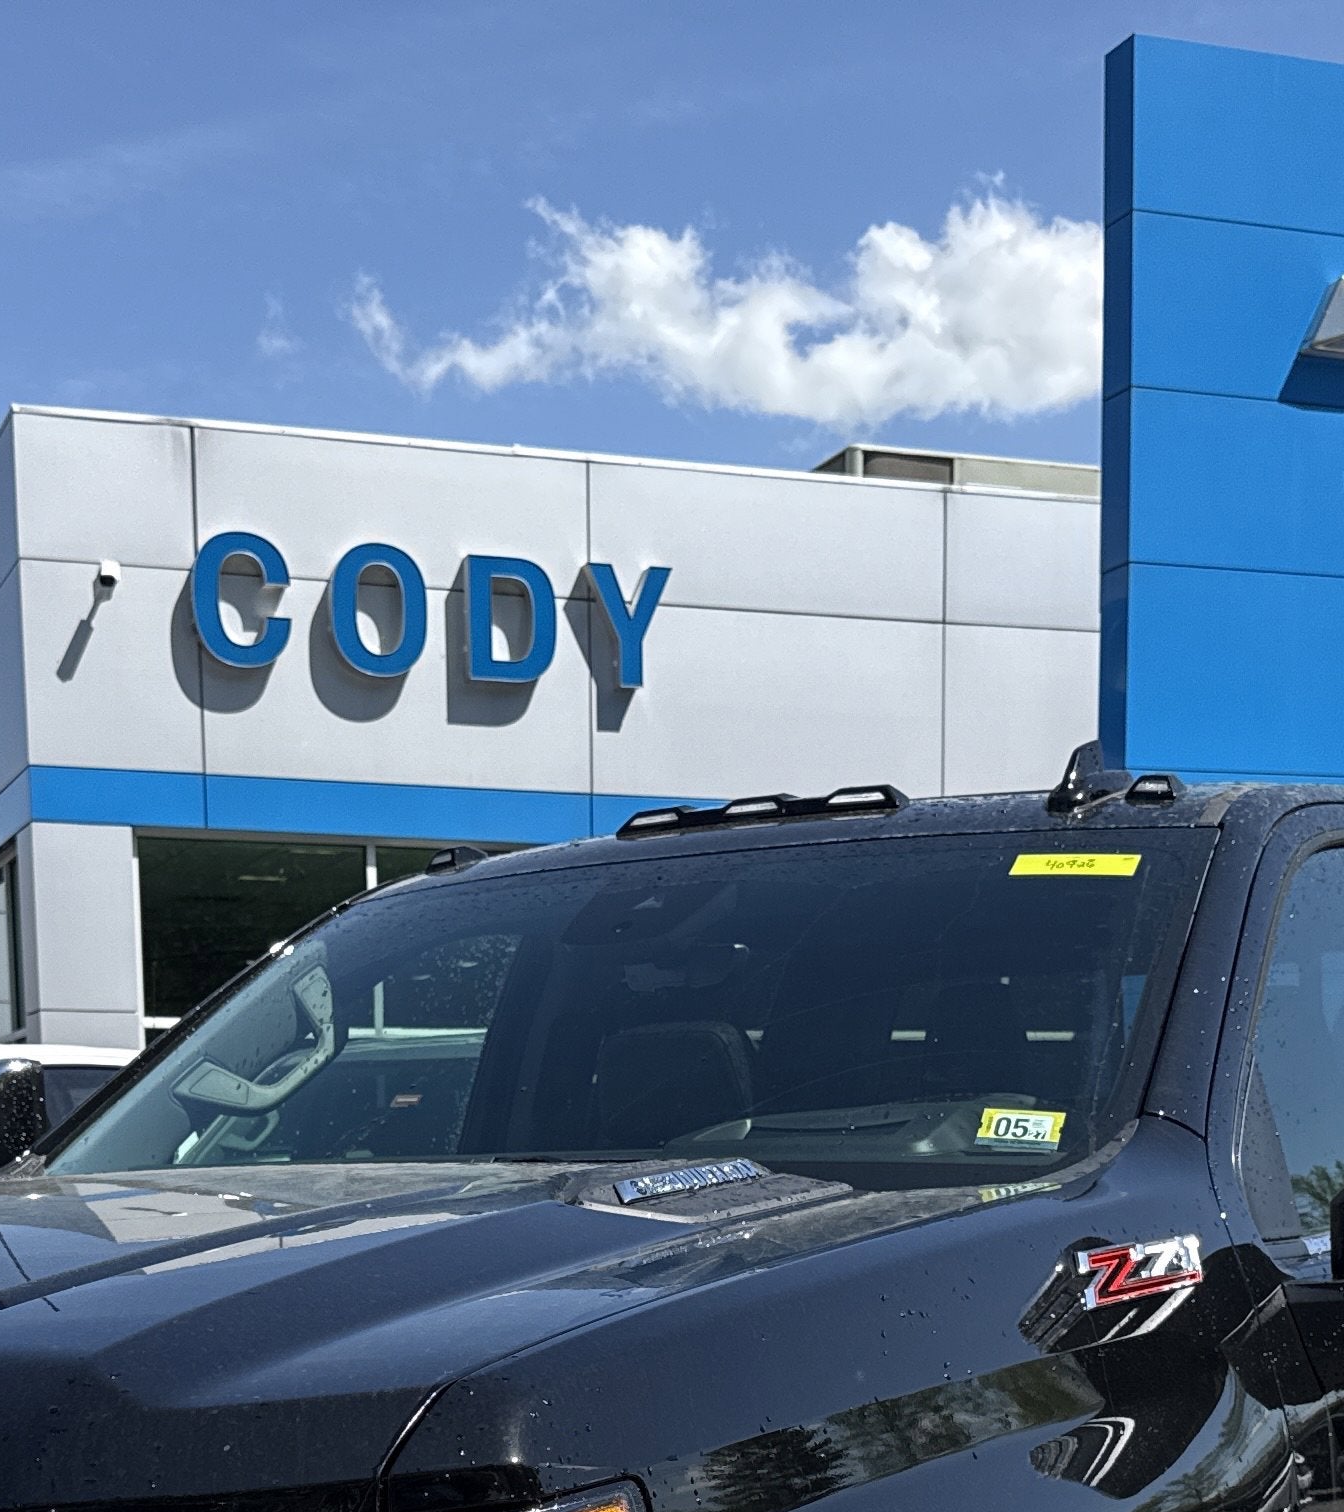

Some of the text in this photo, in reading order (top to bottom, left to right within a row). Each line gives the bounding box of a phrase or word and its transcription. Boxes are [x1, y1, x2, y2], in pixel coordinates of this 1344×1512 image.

[191, 530, 673, 689] CODY
[993, 1116, 1030, 1139] 05
[1075, 1235, 1203, 1311] Z71
